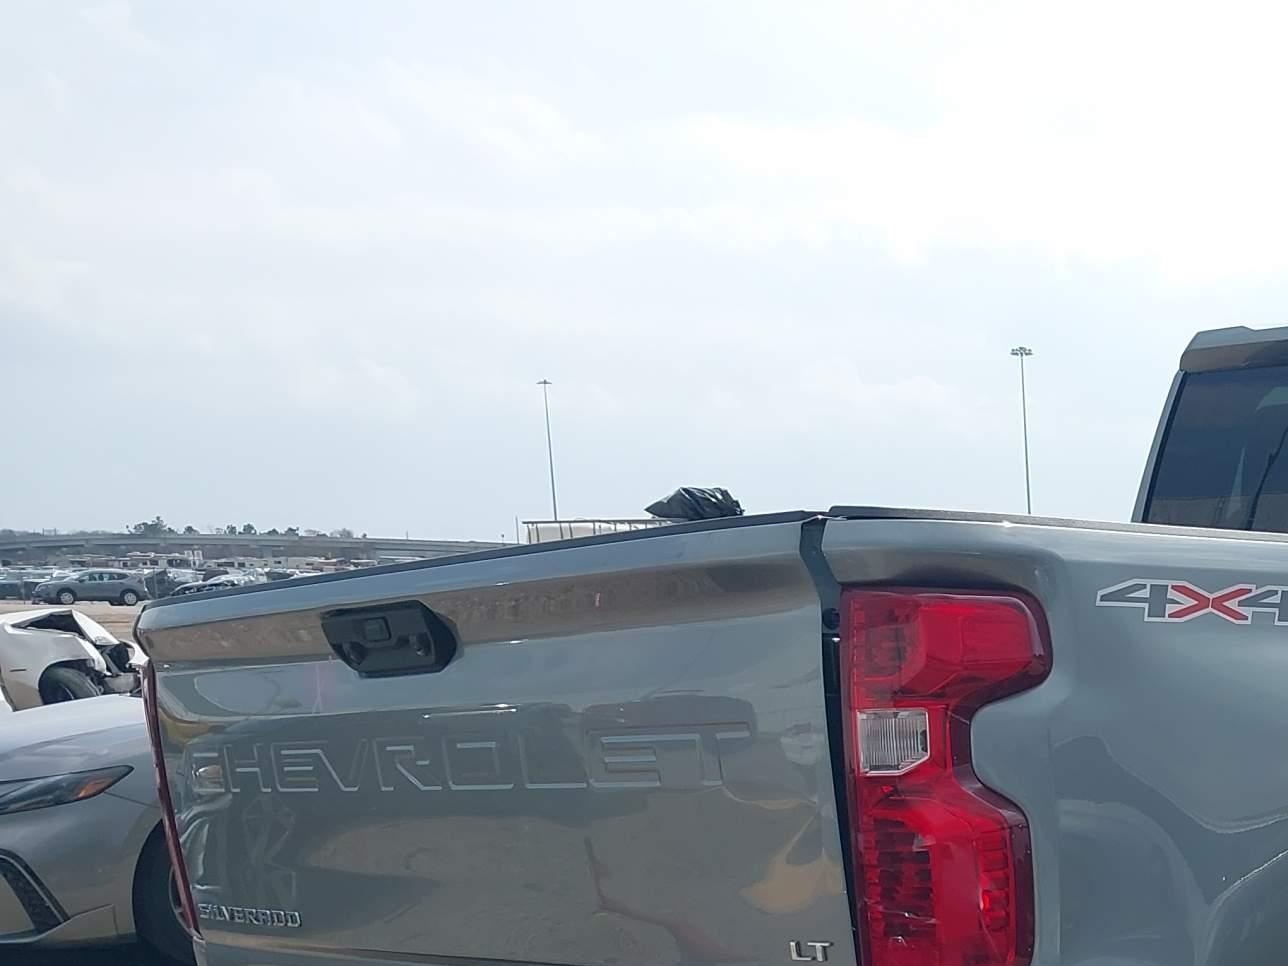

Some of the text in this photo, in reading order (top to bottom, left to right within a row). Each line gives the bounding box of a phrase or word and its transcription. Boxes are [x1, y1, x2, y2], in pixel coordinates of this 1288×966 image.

[191, 719, 752, 793] CHEVROLET
[198, 903, 303, 928] SILVERADO
[790, 940, 834, 962] LT
